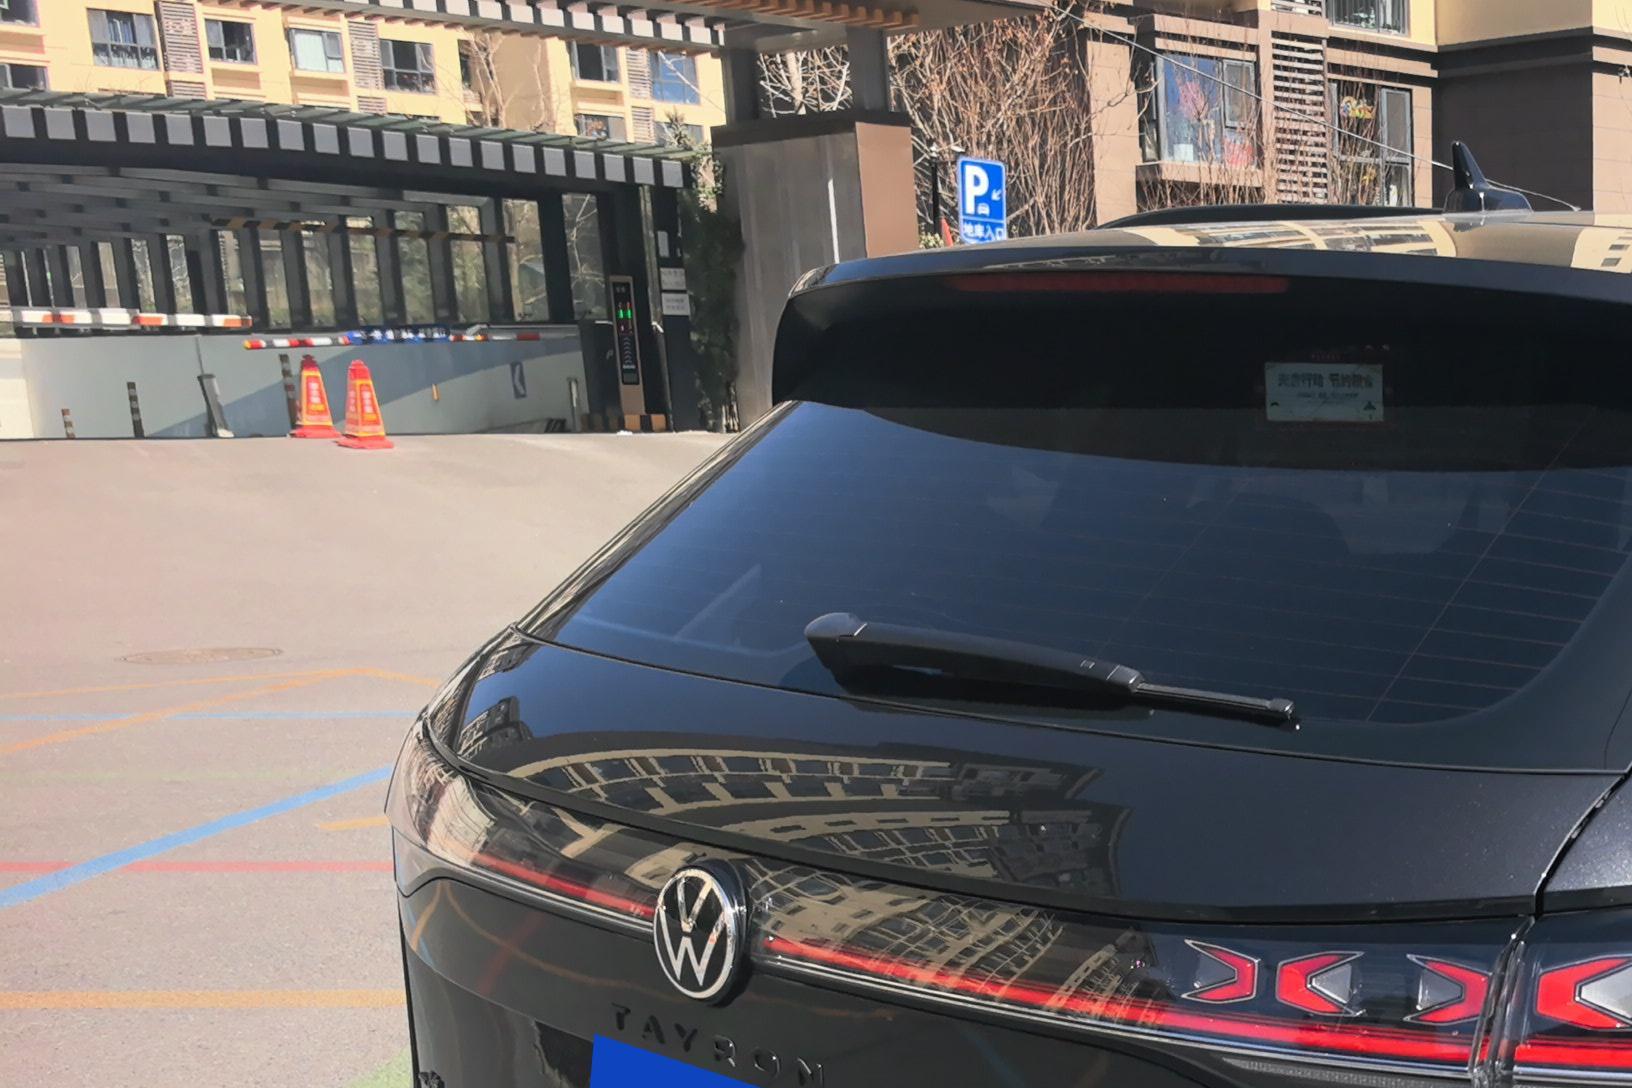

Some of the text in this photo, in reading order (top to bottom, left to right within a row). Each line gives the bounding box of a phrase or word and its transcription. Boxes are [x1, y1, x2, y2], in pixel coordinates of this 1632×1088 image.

[964, 164, 989, 215] P
[963, 222, 1006, 241] 地库入口
[611, 1002, 825, 1088] TAYRON
